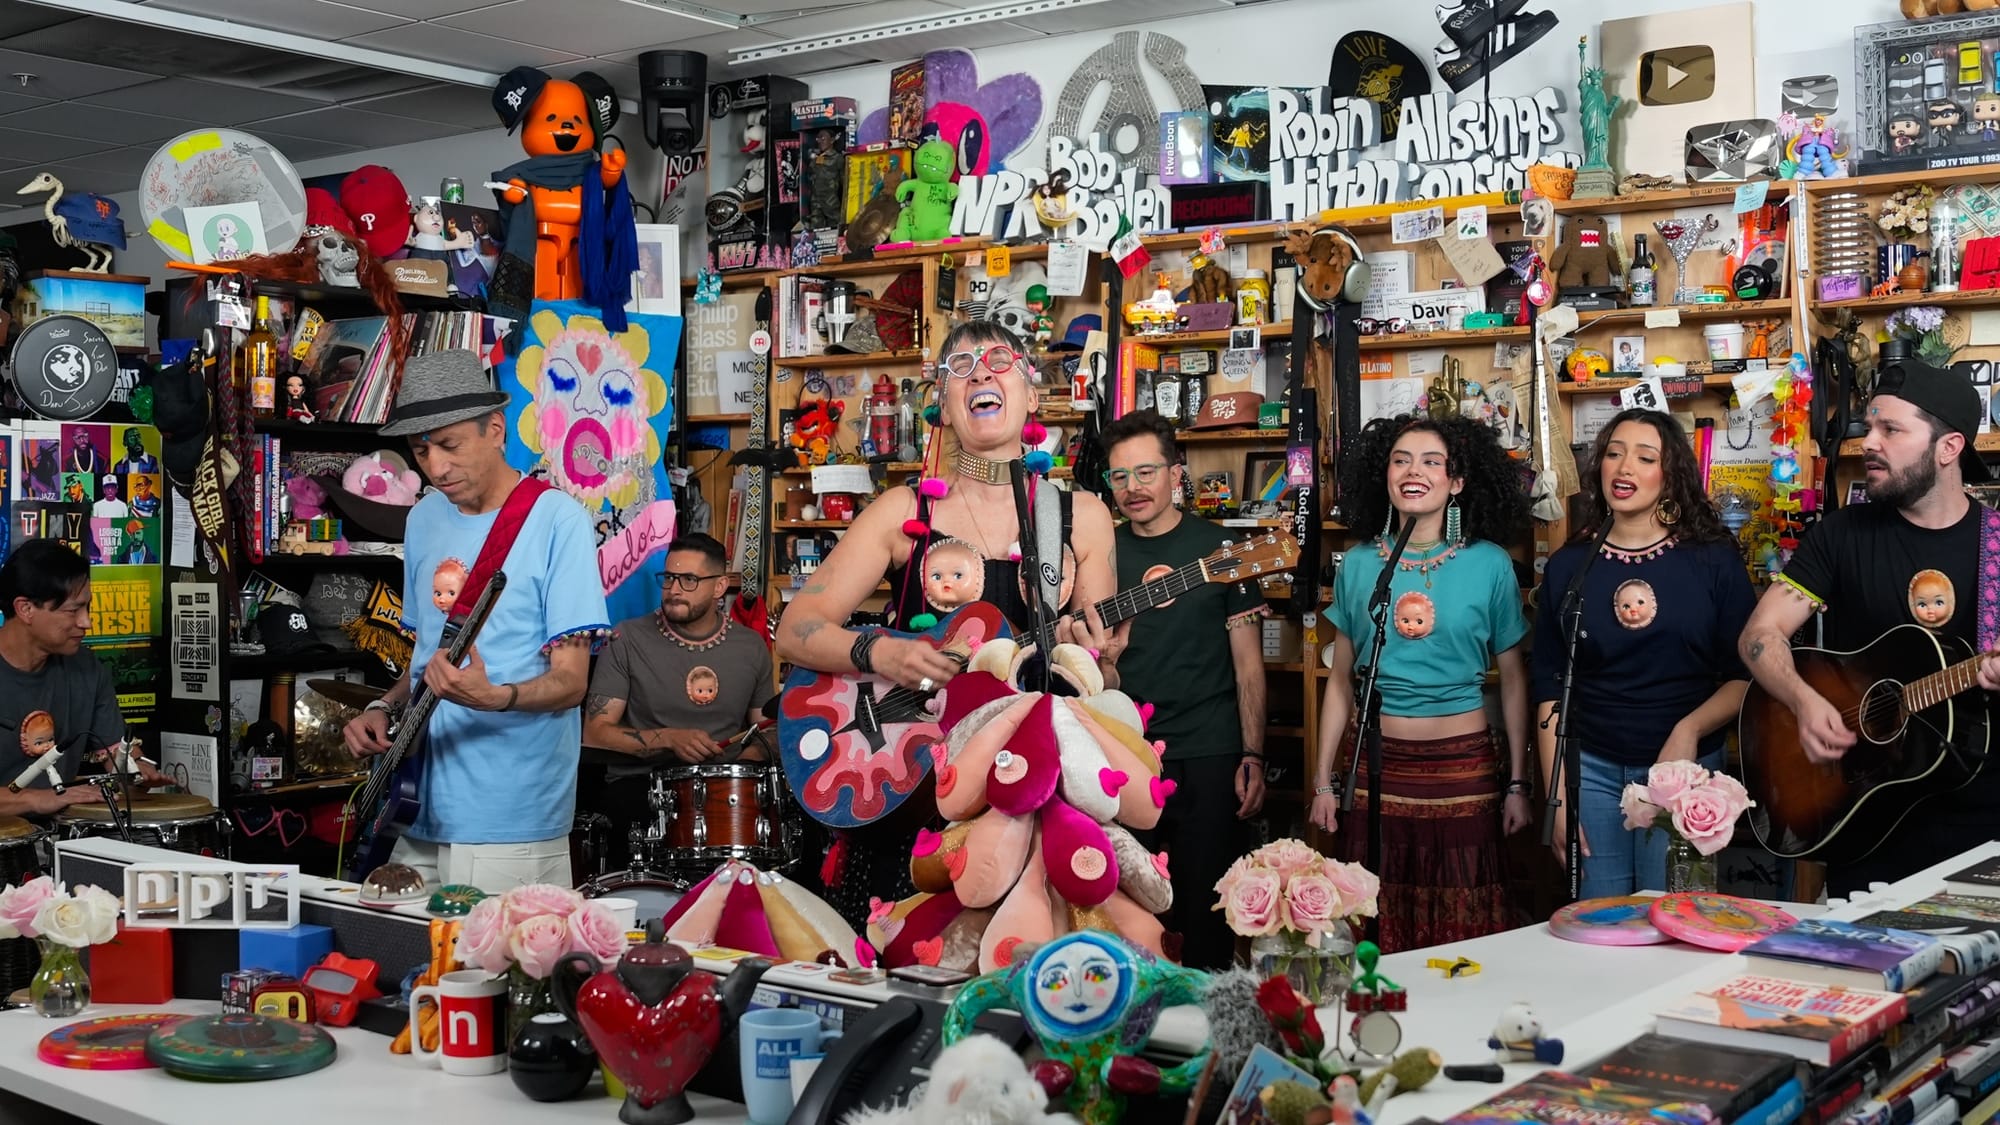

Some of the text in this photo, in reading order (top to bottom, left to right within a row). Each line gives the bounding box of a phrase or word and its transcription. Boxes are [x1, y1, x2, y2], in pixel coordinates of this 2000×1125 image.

[1343, 36, 1389, 63] LOVE
[794, 104, 826, 116] MASTER
[1269, 87, 1380, 162] Robin
[1396, 87, 1562, 170] Allsongs
[1166, 120, 1176, 176] HwaBoon
[1052, 132, 1117, 192] Bob
[1930, 158, 1946, 169] ZOO
[1947, 157, 1958, 167] TV
[1959, 156, 1979, 166] TOUR
[1270, 154, 1408, 225] Hilton
[950, 170, 1052, 240] NPR
[1066, 167, 1172, 252] Boilen
[1174, 194, 1254, 222] RECORDING
[361, 214, 376, 232] P
[718, 241, 757, 269] KISS
[688, 300, 738, 329] Philip
[688, 326, 737, 349] Glass
[688, 351, 716, 374] Pia
[733, 361, 755, 374] MIC
[1367, 361, 1392, 373] LATINO
[734, 392, 753, 404] NE
[1686, 381, 1703, 393] OUT
[1211, 397, 1237, 410] Don't
[1212, 408, 1236, 420] Trip
[1709, 457, 1768, 466] Forgotten Dances
[39, 492, 56, 501] JAZZ
[206, 493, 225, 530] GIRL
[1295, 485, 1310, 545] Rodgers
[21, 508, 83, 540] TINY
[99, 527, 122, 538] LOUDER
[102, 545, 119, 556] RIOT
[91, 591, 151, 613] ANNIE
[136, 871, 274, 920] npr
[1733, 978, 1811, 997] MUSIC
[1715, 987, 1868, 1016] HOW WOMEN
[449, 1010, 479, 1046] n
[758, 1042, 800, 1055] ALL
